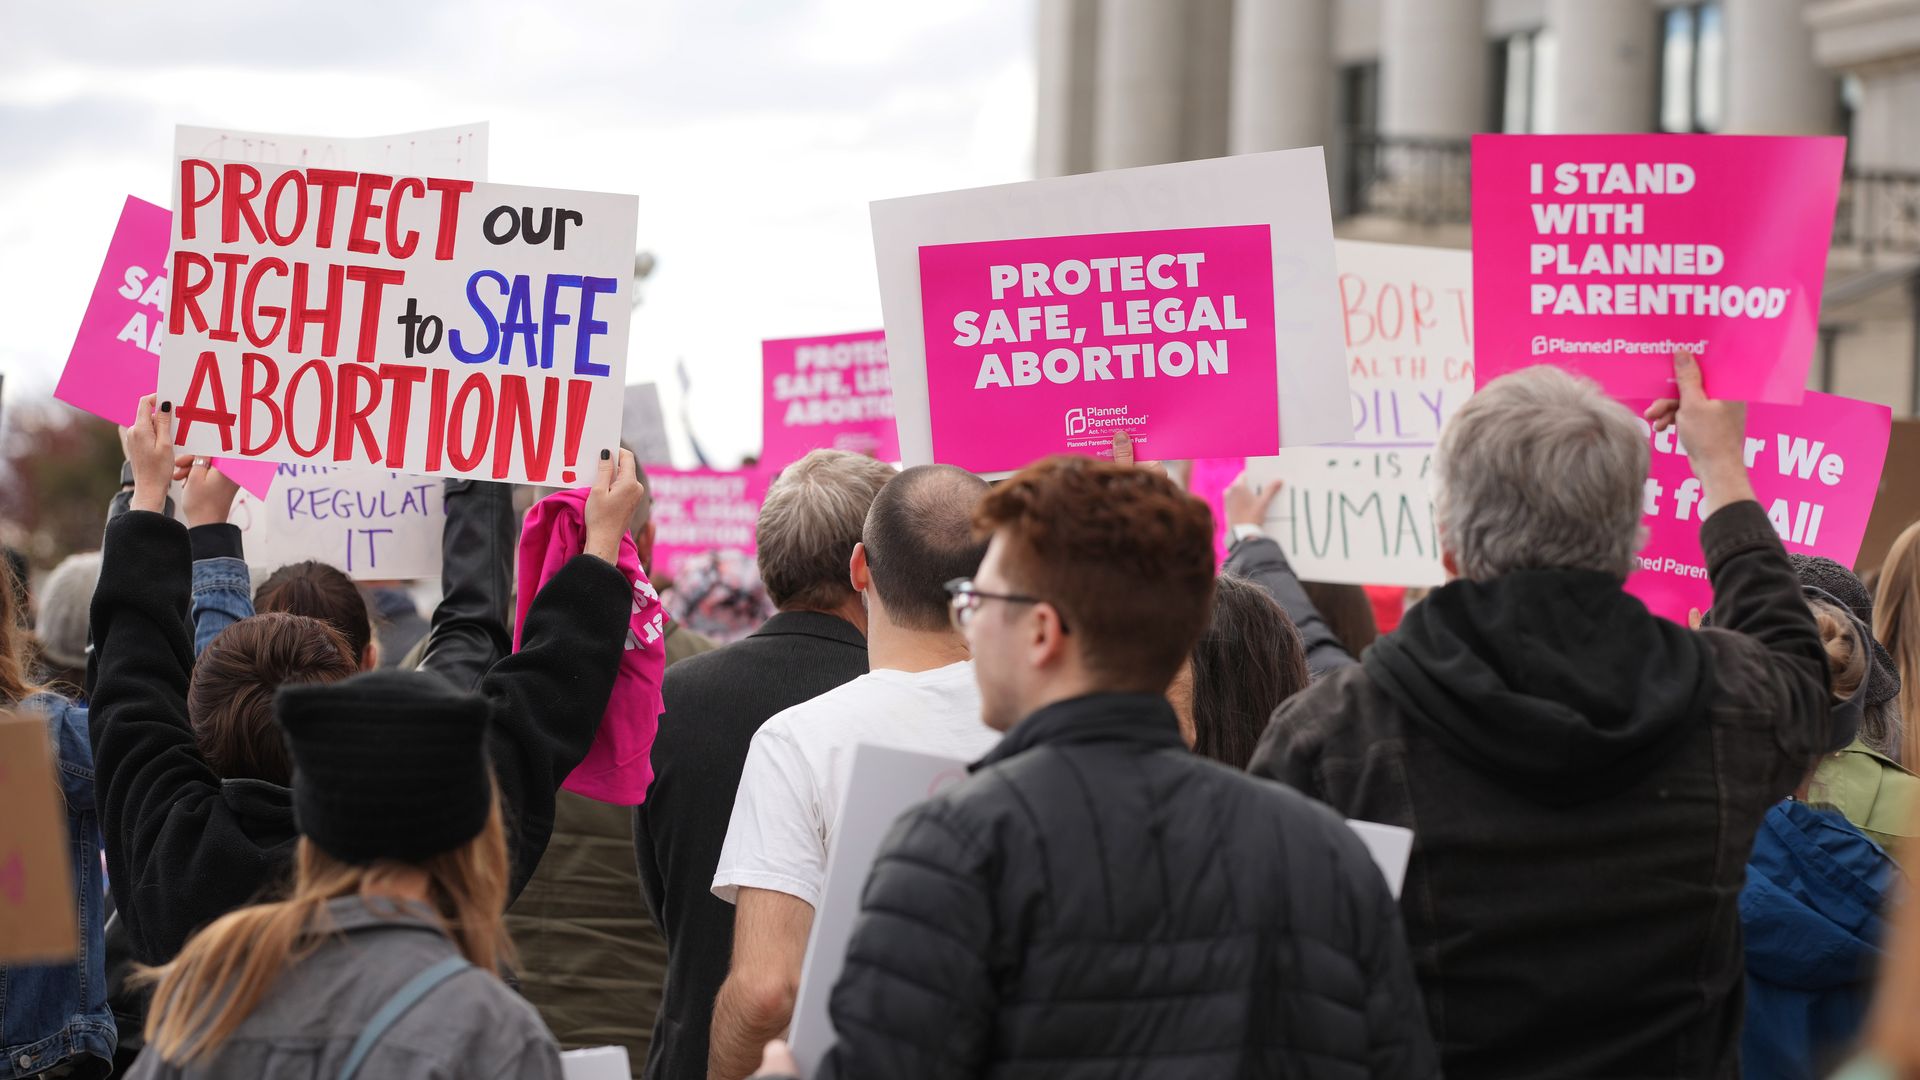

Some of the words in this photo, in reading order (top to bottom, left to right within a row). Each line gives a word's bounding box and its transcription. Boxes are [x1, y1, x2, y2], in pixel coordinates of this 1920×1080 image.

[1530, 163, 1544, 194] I
[1553, 162, 1696, 195] STAND
[180, 158, 475, 261] PROTECT
[482, 204, 584, 251] our
[1530, 203, 1645, 235] WITH
[990, 252, 1205, 300] PROTECT
[1530, 244, 1725, 275] PLANNED
[118, 265, 168, 313] SA
[1530, 284, 1787, 319] PARENTHOOD
[168, 250, 406, 363] RIGHT
[398, 298, 443, 358] to
[448, 269, 618, 377] SAFE
[953, 304, 1087, 347] SAFE,
[1101, 295, 1247, 336] LEGAL
[974, 340, 1229, 389] ABORTION
[1550, 338, 1612, 354] Planned
[174, 351, 593, 483] ABORTION!
[1086, 404, 1128, 417] Planned
[1087, 414, 1147, 428] Parenthood
[1777, 433, 1844, 486] We
[287, 484, 449, 521] REGULAT
[1767, 498, 1824, 547] All
[347, 529, 394, 572] IT
